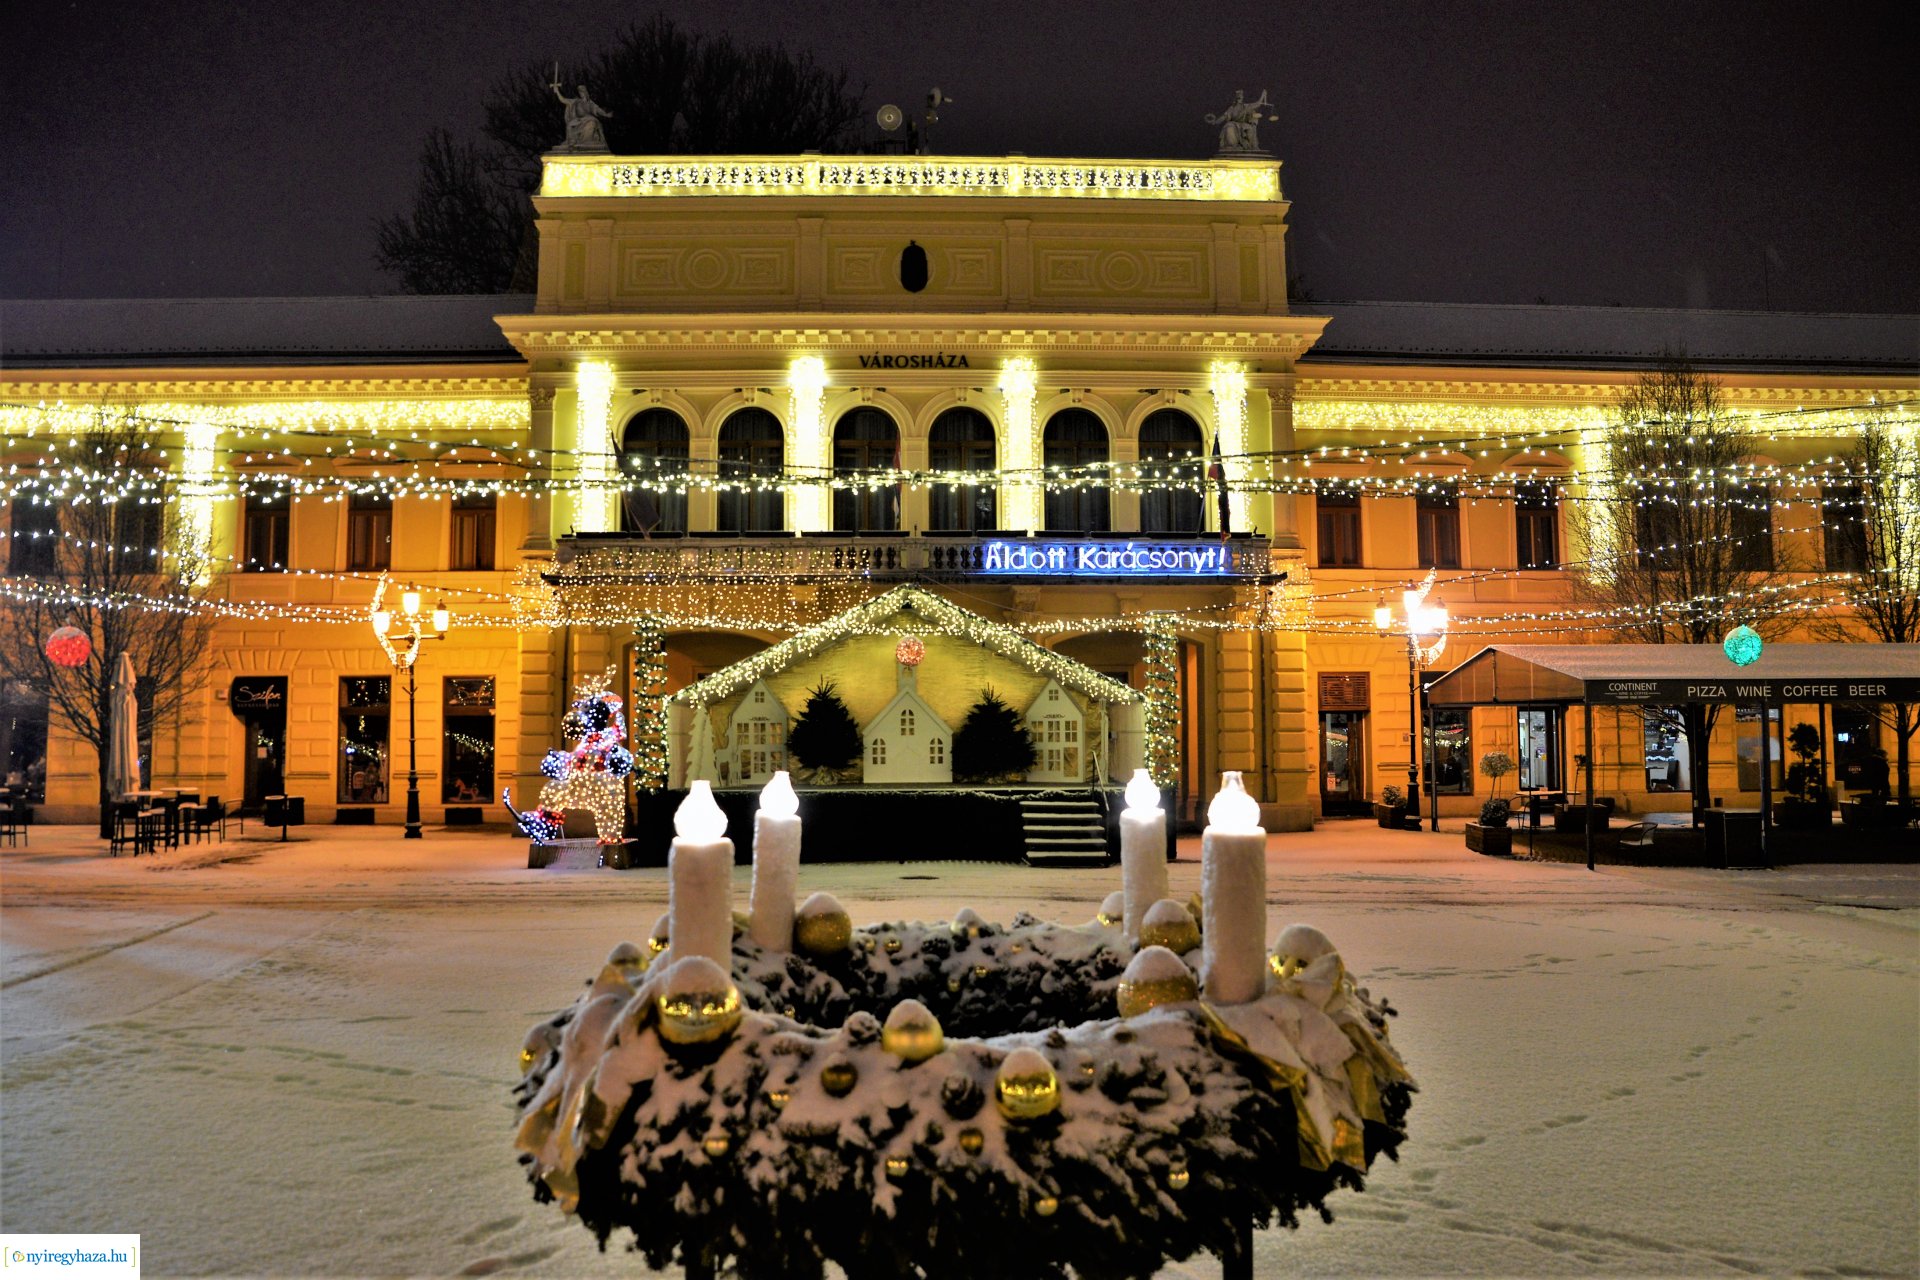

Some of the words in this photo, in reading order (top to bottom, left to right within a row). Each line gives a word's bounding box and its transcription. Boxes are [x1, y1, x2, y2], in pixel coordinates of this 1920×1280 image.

[859, 351, 969, 369] VÁROSHÁZA
[985, 542, 1066, 570] Áldott
[1078, 542, 1226, 574] Karácsonyt!
[1608, 682, 1657, 692] CONTINENT
[1687, 686, 1727, 697] PIZZA
[1736, 685, 1772, 697] WINE
[1783, 685, 1839, 697] COFFEE
[1849, 685, 1887, 696] BEER
